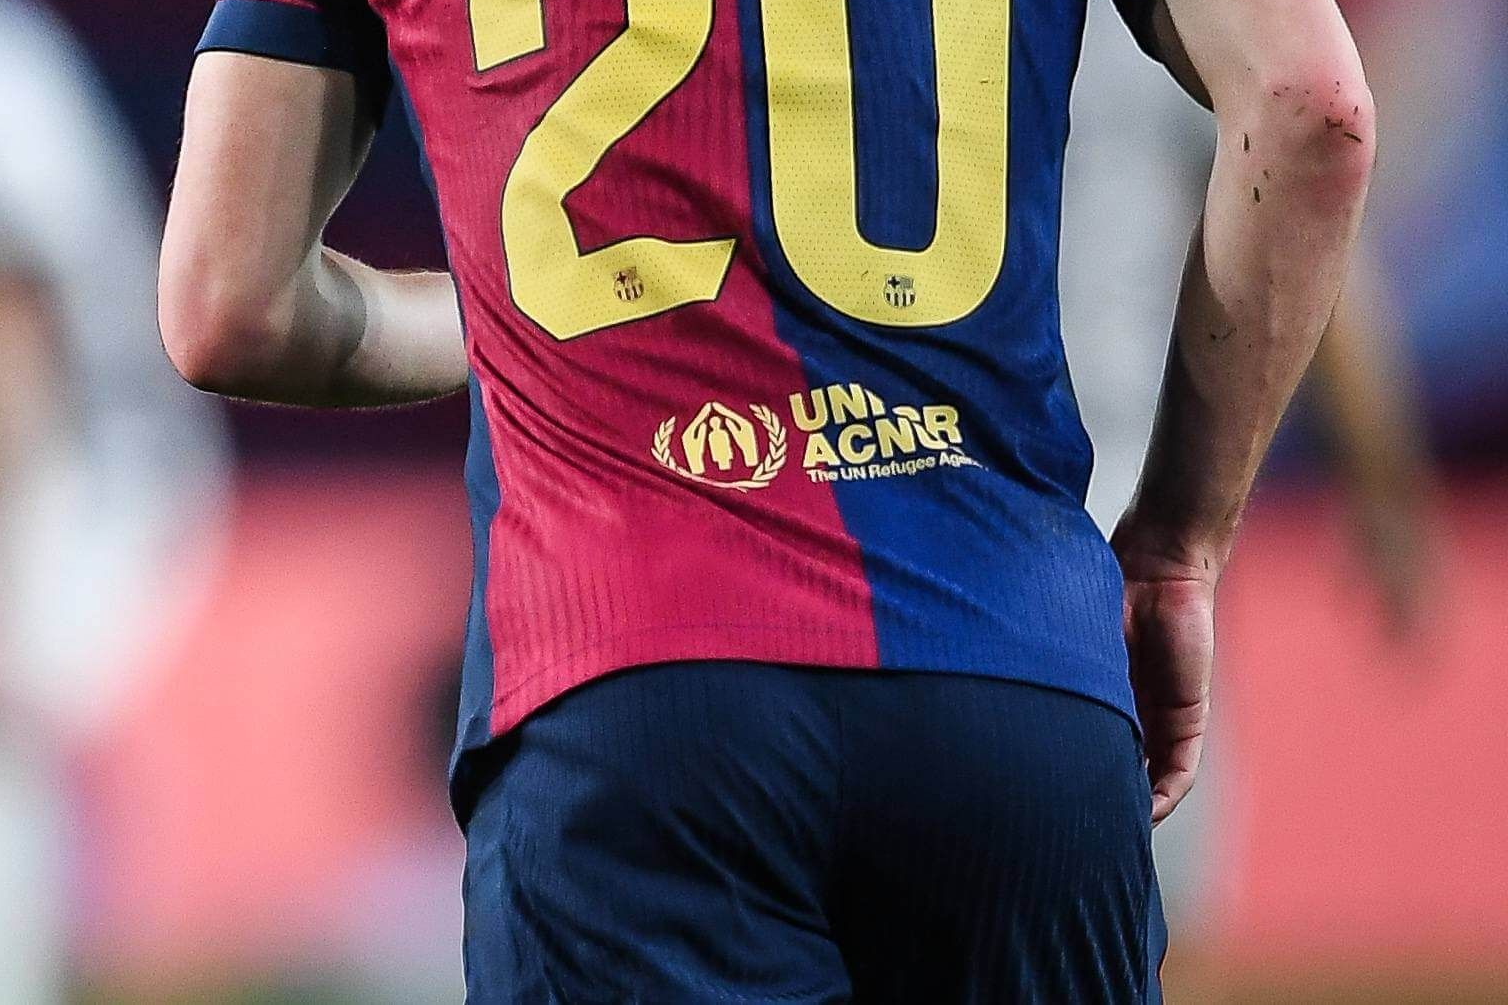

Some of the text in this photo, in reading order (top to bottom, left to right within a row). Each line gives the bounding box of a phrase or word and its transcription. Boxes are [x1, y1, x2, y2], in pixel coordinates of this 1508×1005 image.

[806, 468, 839, 483] The
[840, 464, 868, 481] UN
[869, 455, 936, 479] Refugee
